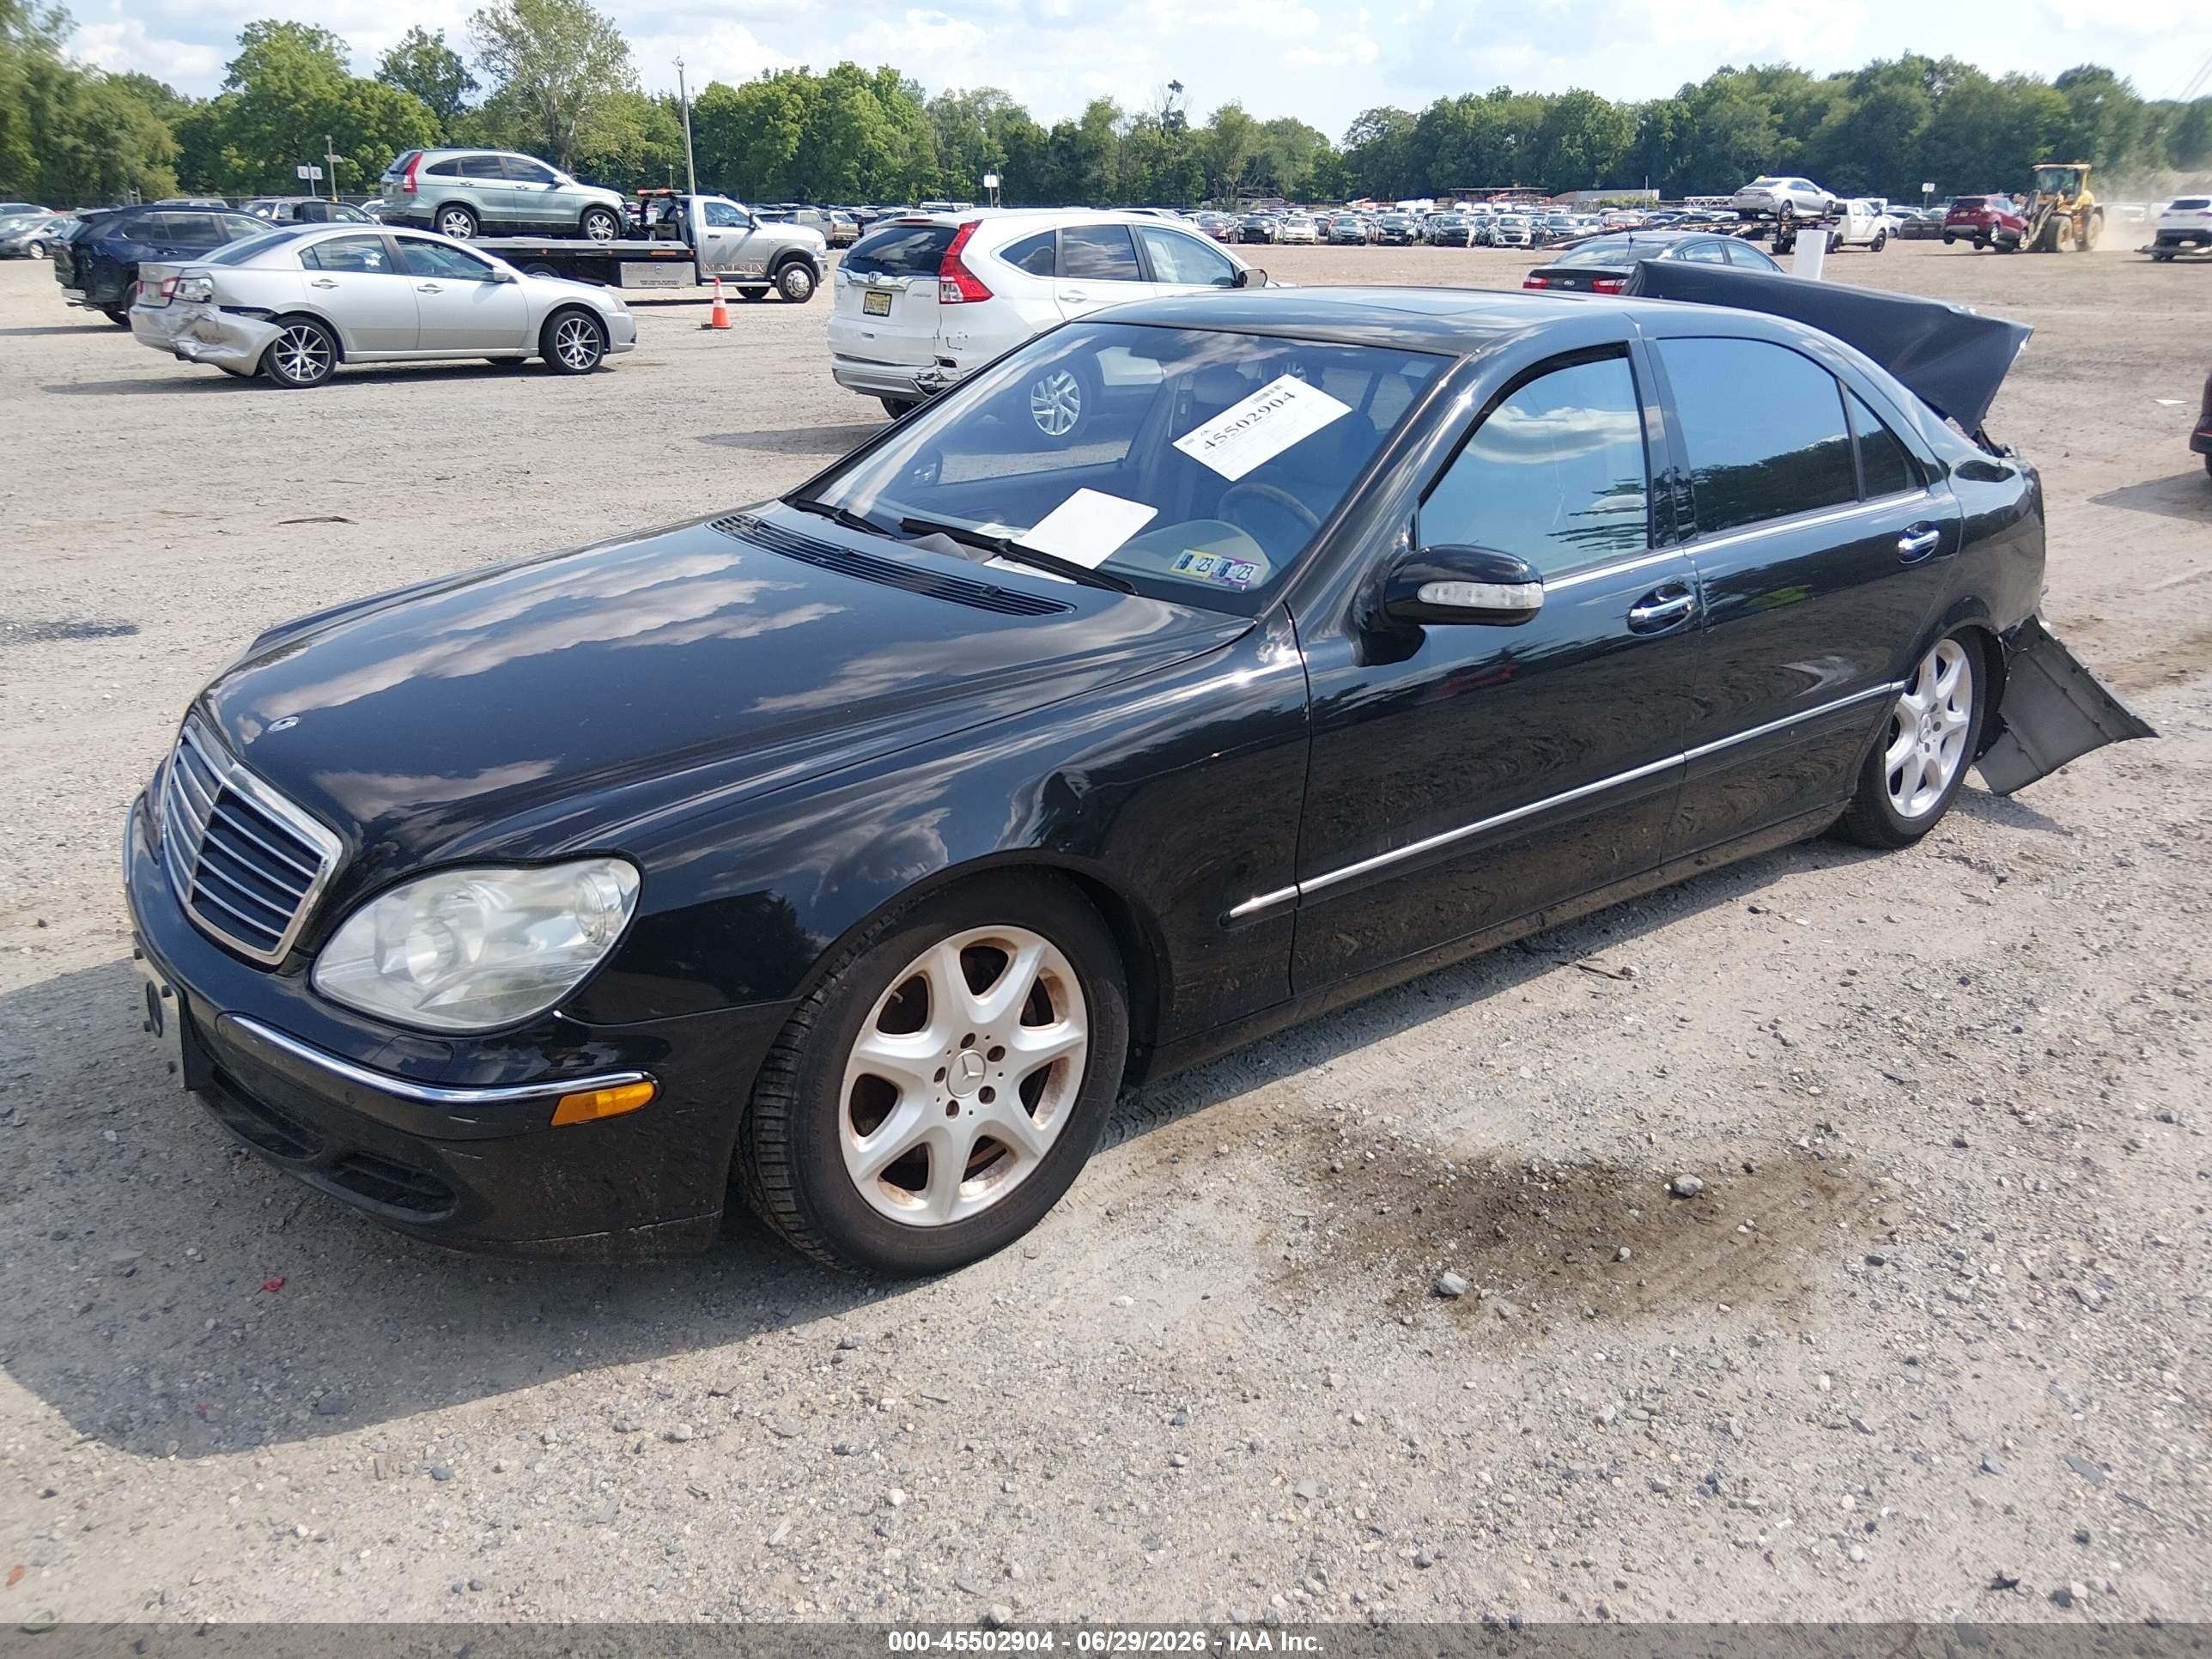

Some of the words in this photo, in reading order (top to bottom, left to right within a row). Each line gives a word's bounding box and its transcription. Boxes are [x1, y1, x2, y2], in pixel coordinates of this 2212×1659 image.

[703, 264, 764, 273] MATRIX
[1204, 391, 1297, 451] 45502904
[1237, 565, 1254, 580] 23
